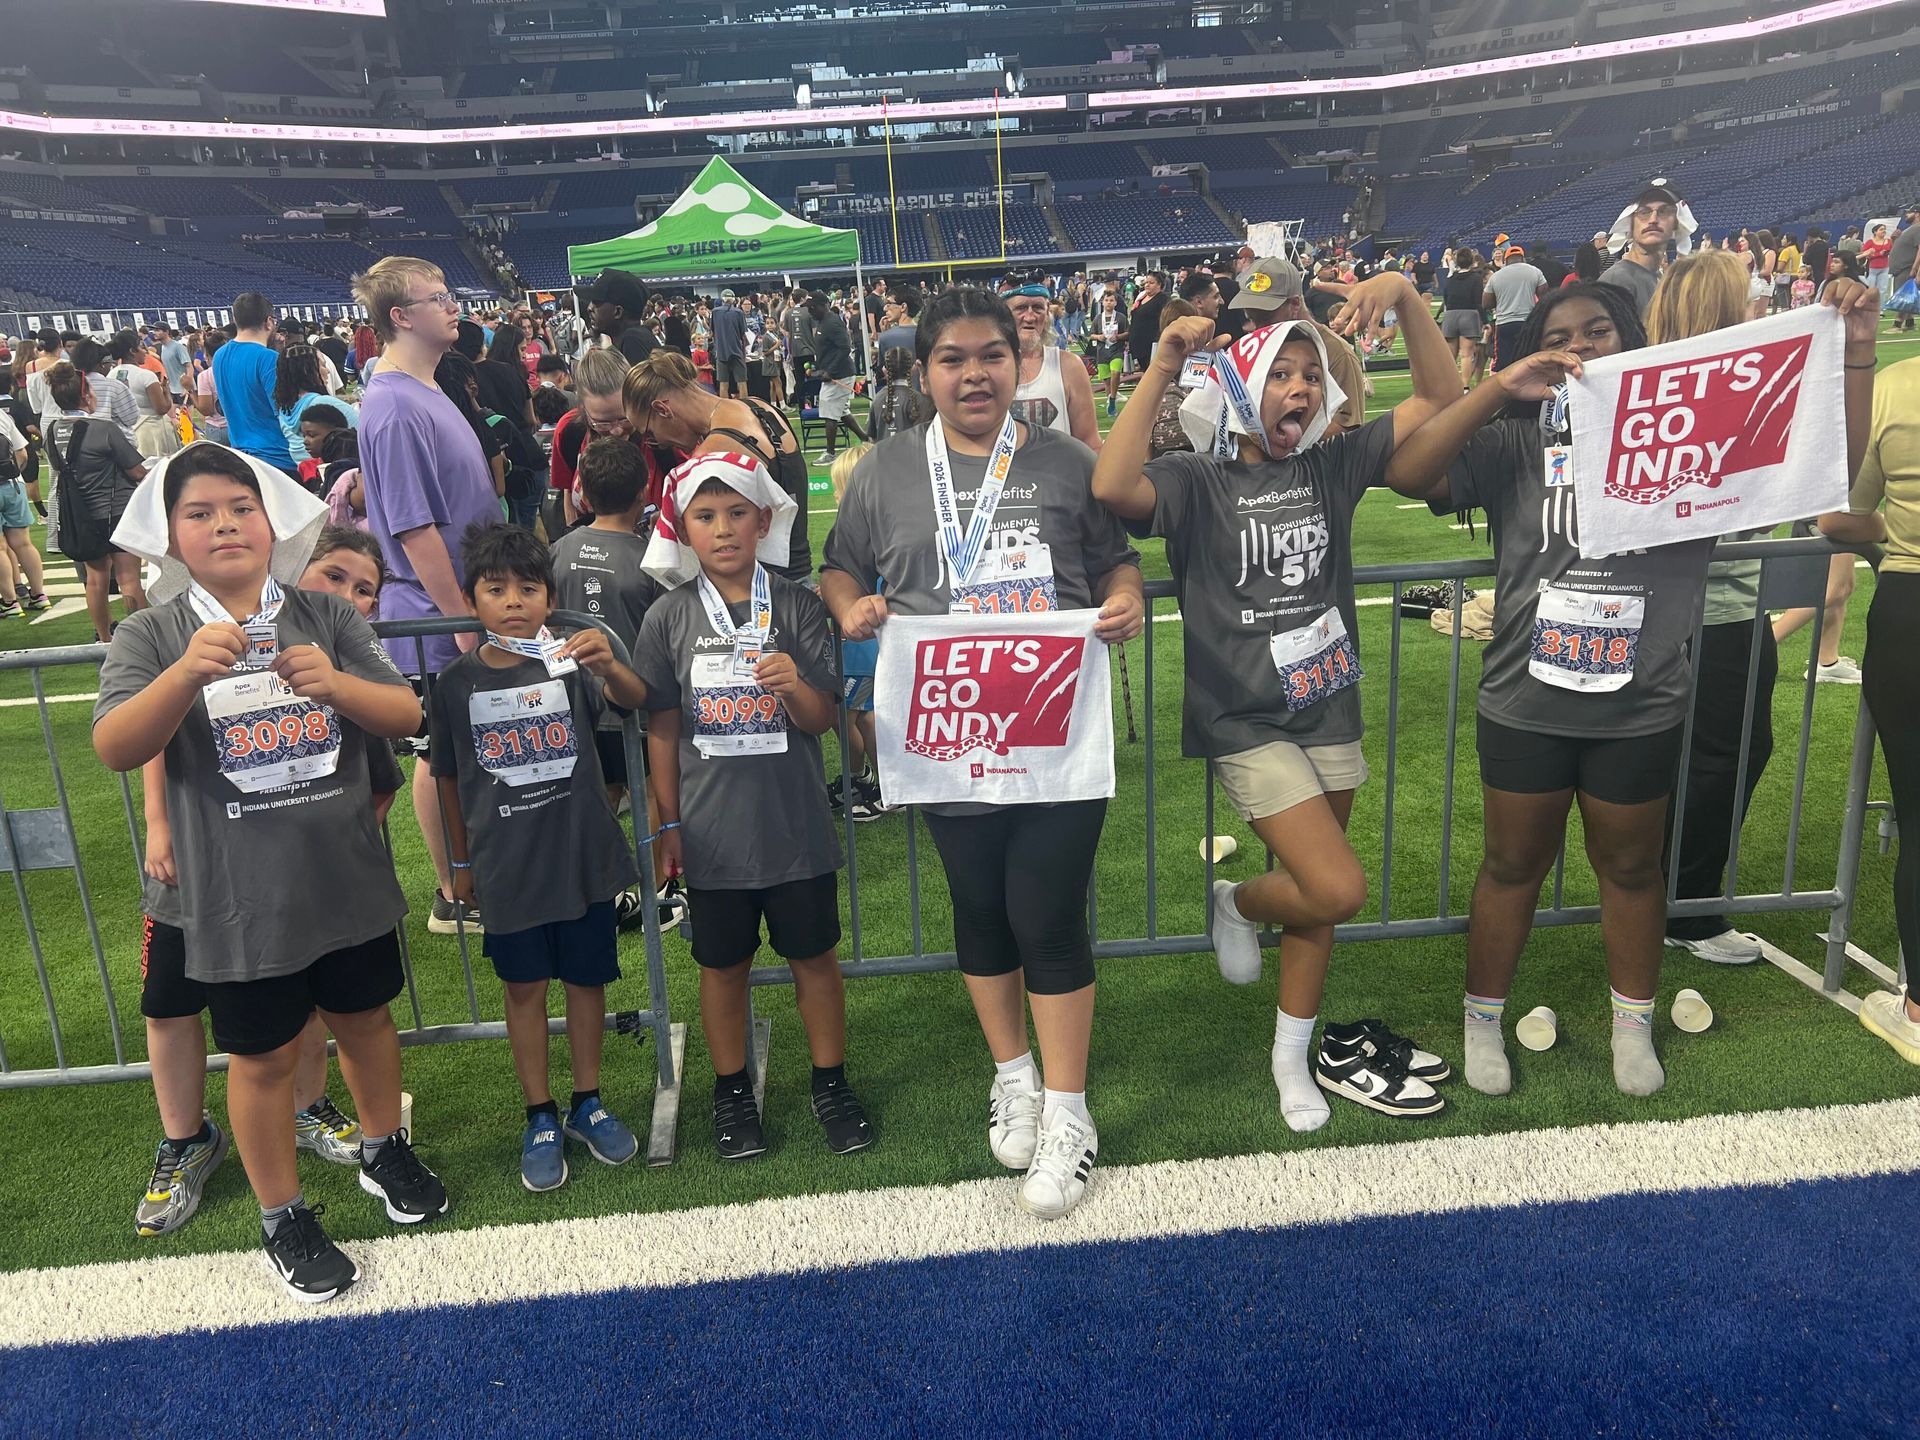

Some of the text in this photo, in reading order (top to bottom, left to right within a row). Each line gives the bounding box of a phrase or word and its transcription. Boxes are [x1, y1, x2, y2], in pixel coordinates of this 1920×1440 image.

[963, 190, 1014, 207] COLTS
[729, 239, 762, 253] tee
[711, 271, 778, 279] STADIUM
[1626, 352, 1765, 410] LET'S
[1620, 406, 1696, 449] GO
[1001, 442, 1014, 457] 5K
[989, 440, 1005, 477] MONUMENTAL
[1616, 435, 1738, 486] INDY
[933, 461, 943, 482] 2026
[993, 455, 1011, 481] KIDS
[936, 481, 953, 523] FINISHER
[978, 495, 989, 511] Apex
[985, 489, 1000, 514] Benefits
[1694, 496, 1741, 511] INDIANAPOLIS
[580, 543, 600, 553] Apex
[1272, 521, 1329, 560] KIDS
[579, 551, 606, 562] Benefits
[1008, 553, 1027, 563] KIDS
[1012, 562, 1027, 571] 5K
[1281, 547, 1328, 587] 5K
[1570, 583, 1644, 592] UNIVERSITY INDIANAPOLIS
[758, 601, 770, 613] 5K
[1274, 606, 1303, 617] UNIVERSITY
[1602, 602, 1622, 611] KIDS
[1603, 610, 1620, 619] 5K
[259, 646, 274, 655] 5K
[1540, 630, 1629, 664] 3118
[923, 640, 1042, 677] LET'S
[1290, 647, 1349, 698] 3111
[235, 687, 260, 697] Benefits
[524, 690, 542, 701] KIDS
[919, 678, 981, 709] GO
[528, 699, 543, 709] 5K
[699, 694, 777, 725] 3099
[225, 711, 330, 758] 3098
[915, 712, 1019, 743] INDY
[482, 721, 568, 759] 3110
[986, 767, 1028, 775] INDIANAPOLIS
[242, 788, 344, 812] INDIANA UNIVERSITY INDIANAPOLIS
[521, 788, 550, 799] PRESENTED
[511, 796, 556, 812] INDIANA UNIVERSITY
[1002, 1077, 1021, 1086] adidas
[588, 1109, 608, 1126] NIKE
[1066, 1121, 1085, 1135] adidas
[532, 1130, 556, 1146] NIKE
